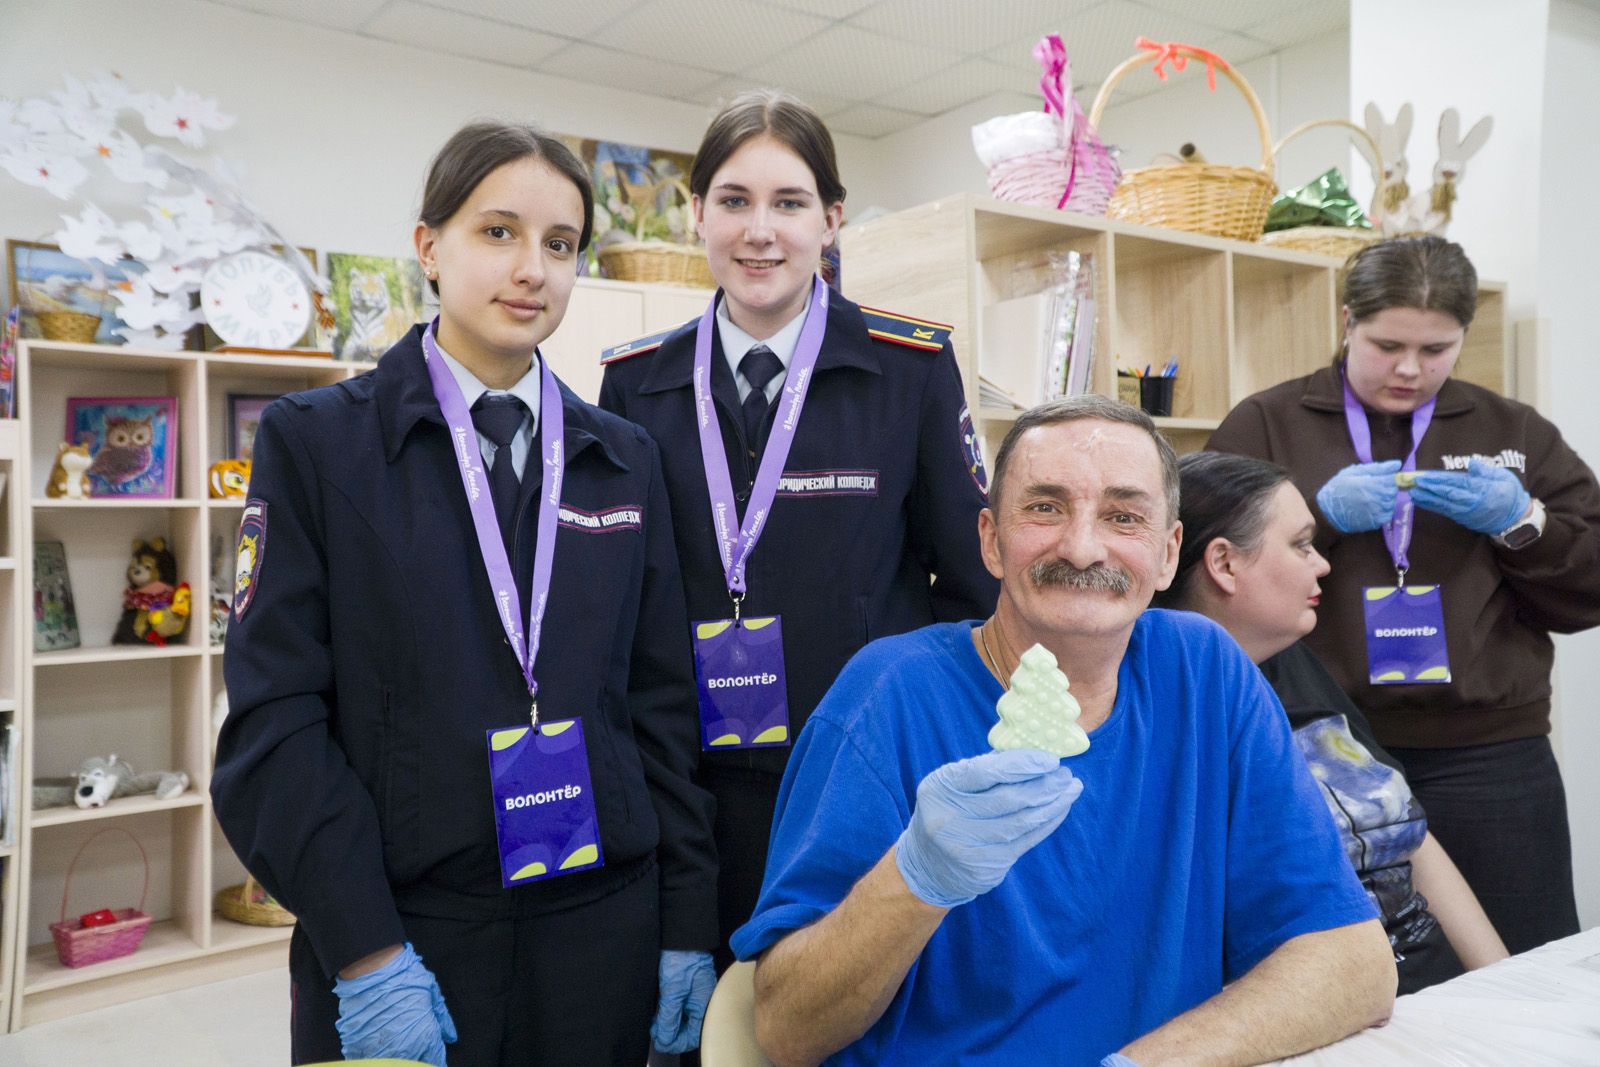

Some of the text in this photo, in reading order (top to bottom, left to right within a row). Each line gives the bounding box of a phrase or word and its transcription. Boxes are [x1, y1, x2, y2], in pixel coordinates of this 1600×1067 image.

[213, 314, 302, 343] МИРА
[837, 476, 876, 490] КОЛЛЕДЖ
[558, 509, 641, 527] ИДИЧЕСКИЙ КОЛЛЕДЖ
[1375, 626, 1438, 637] ВОЛОНТЁР
[708, 672, 777, 688] ВОЛОНТЁР
[505, 785, 582, 810] ВОЛОНТЁР
